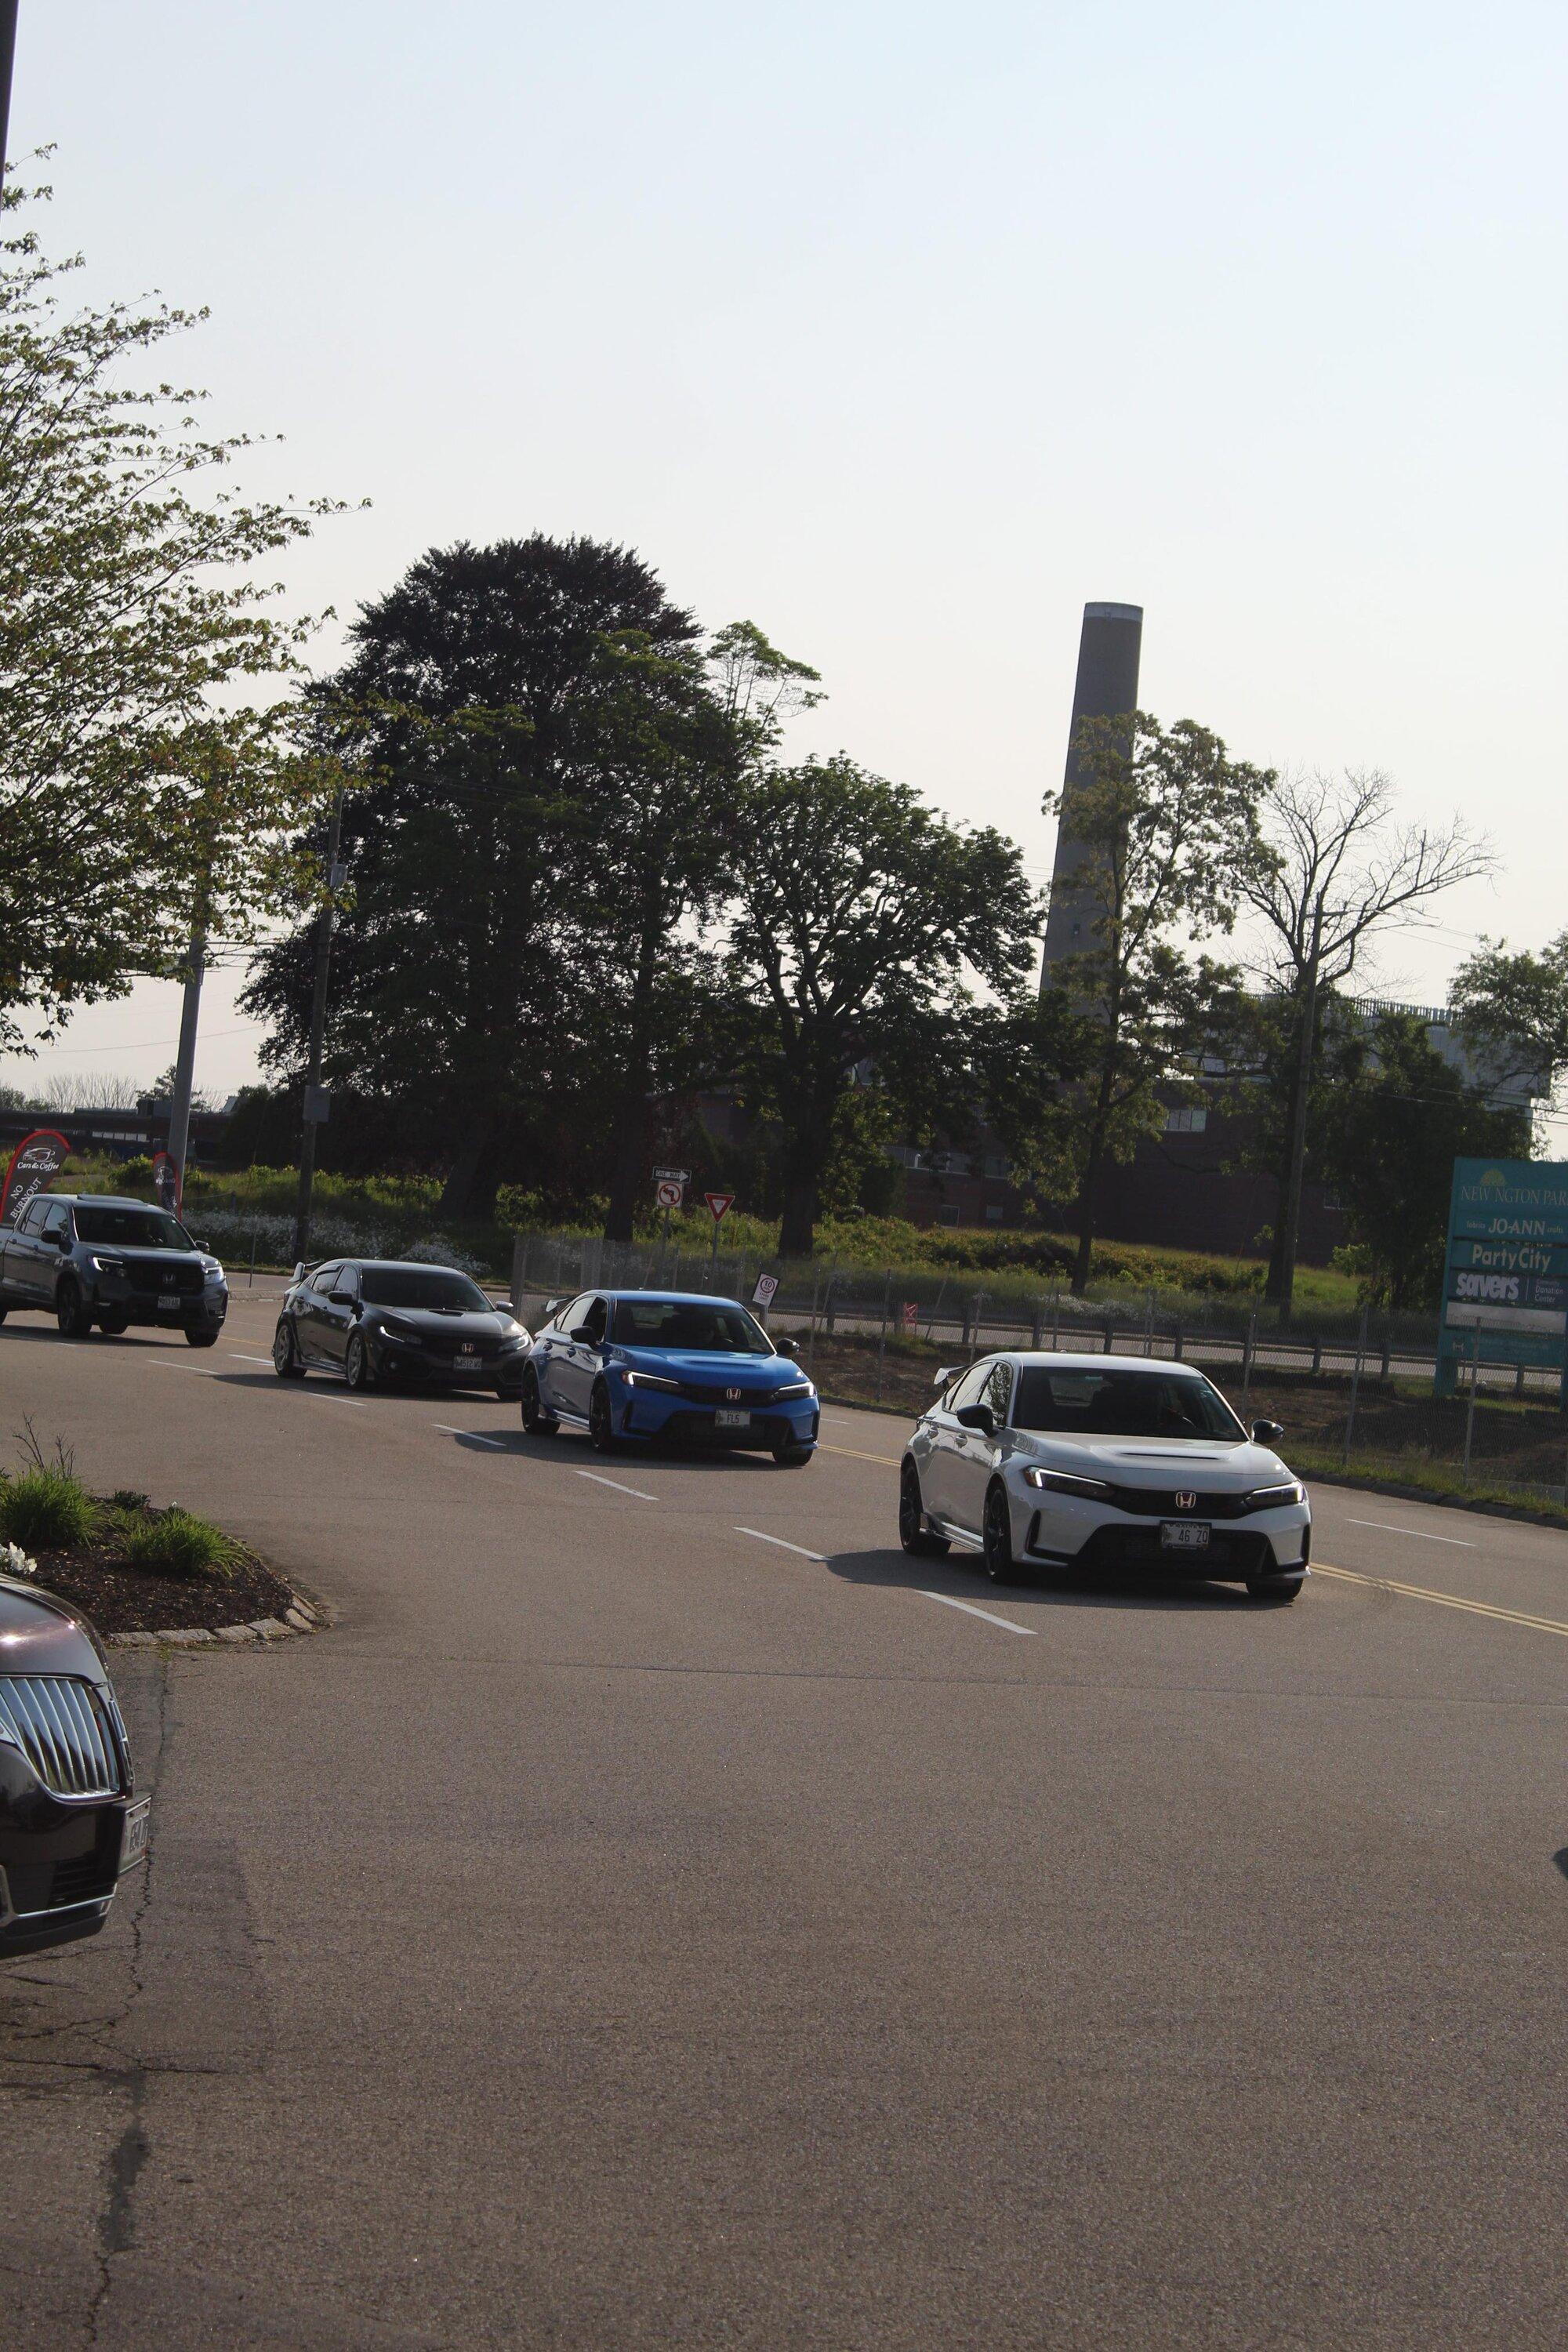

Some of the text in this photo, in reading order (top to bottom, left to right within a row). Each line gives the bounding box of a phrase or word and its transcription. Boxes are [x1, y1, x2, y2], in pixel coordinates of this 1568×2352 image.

[39, 1162, 59, 1171] Coffee
[10, 1185, 24, 1200] NO
[1535, 1285, 1563, 1294] Donation
[1534, 1294, 1556, 1302] Center
[727, 1414, 739, 1424] FL5
[1178, 1529, 1190, 1542] 46
